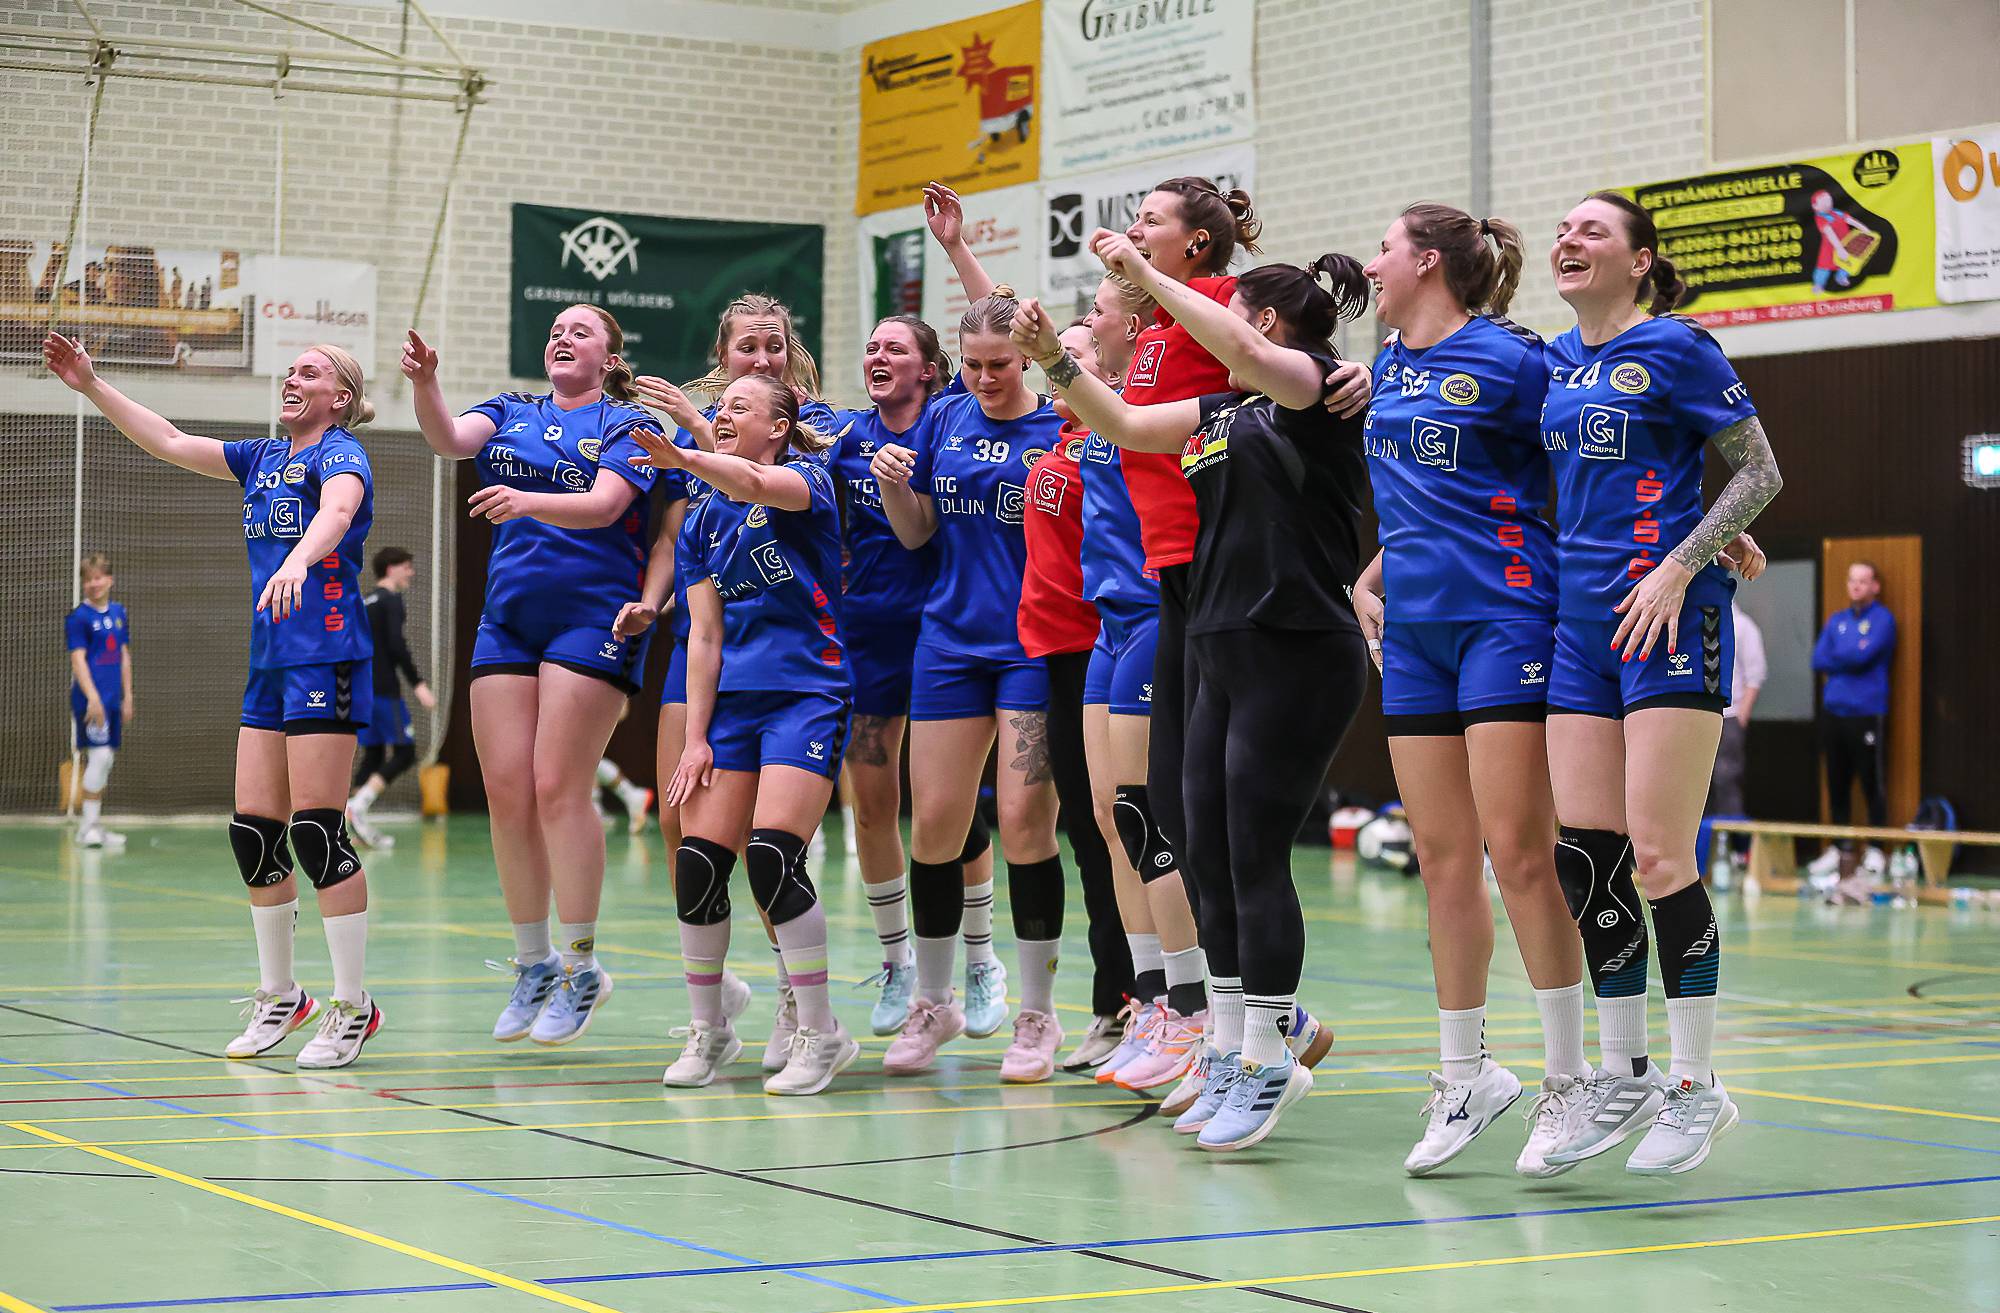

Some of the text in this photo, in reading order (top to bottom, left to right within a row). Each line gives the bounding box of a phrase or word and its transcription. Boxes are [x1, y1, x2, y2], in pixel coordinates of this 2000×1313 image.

[489, 446, 517, 461] ITG
[972, 438, 1010, 464] 39
[321, 453, 345, 472] ITG
[1667, 667, 1693, 677] hummel
[1520, 676, 1545, 685] hummel
